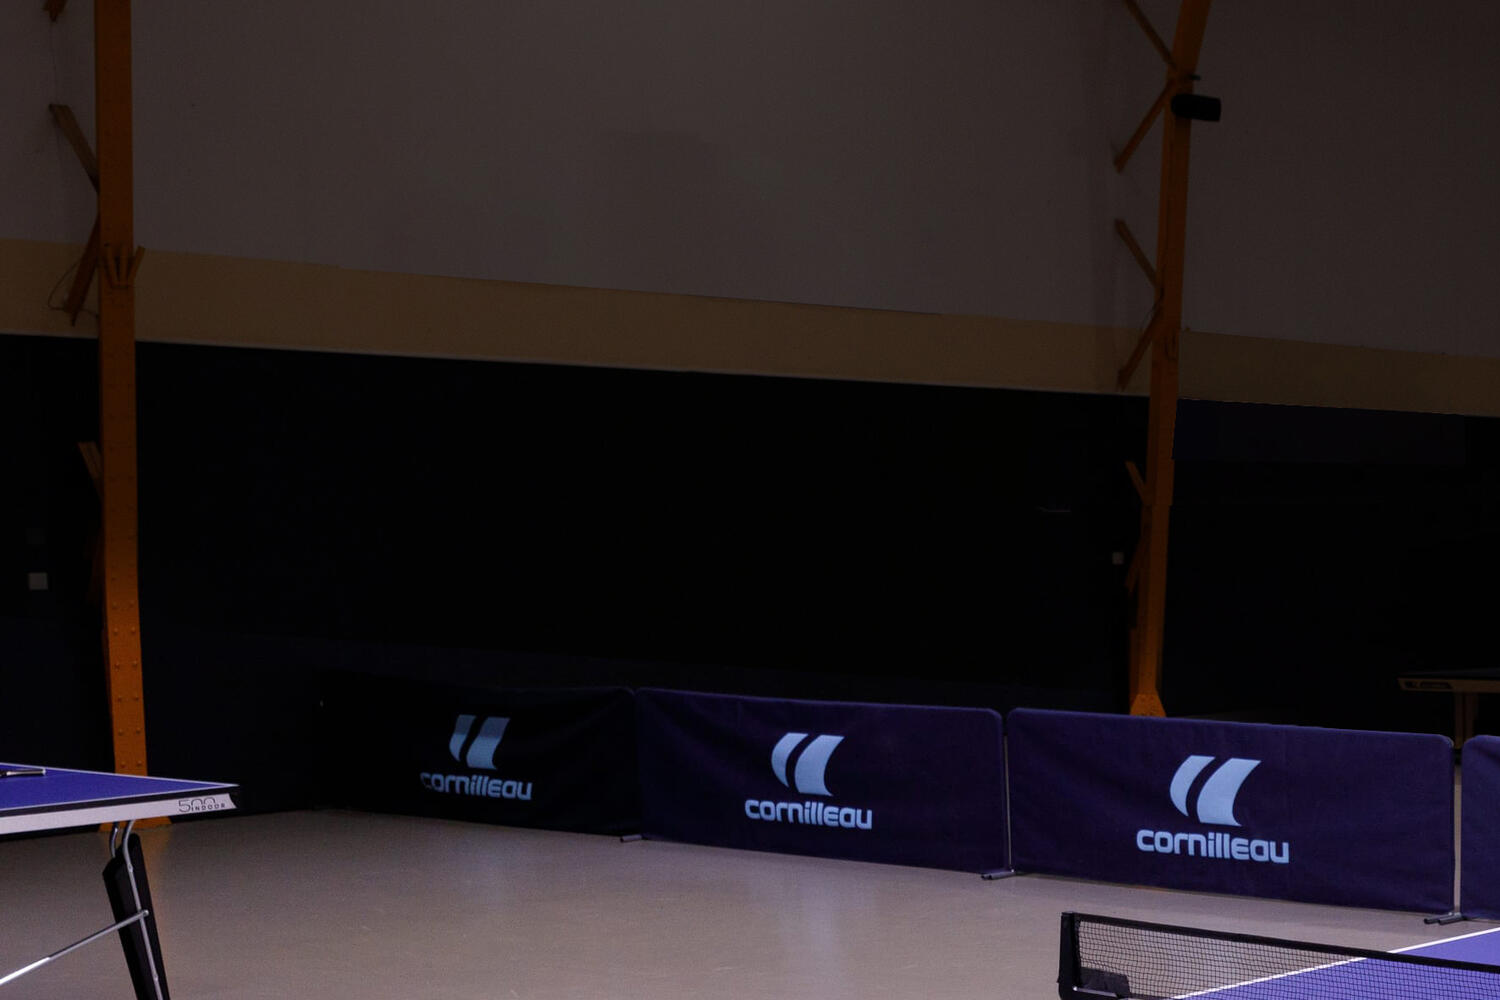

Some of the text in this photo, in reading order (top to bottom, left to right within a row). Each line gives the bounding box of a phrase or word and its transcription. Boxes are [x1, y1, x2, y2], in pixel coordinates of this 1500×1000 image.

[420, 772, 532, 800] cornilleau
[745, 799, 872, 829] cornilleau
[1136, 829, 1290, 864] cornilleau
